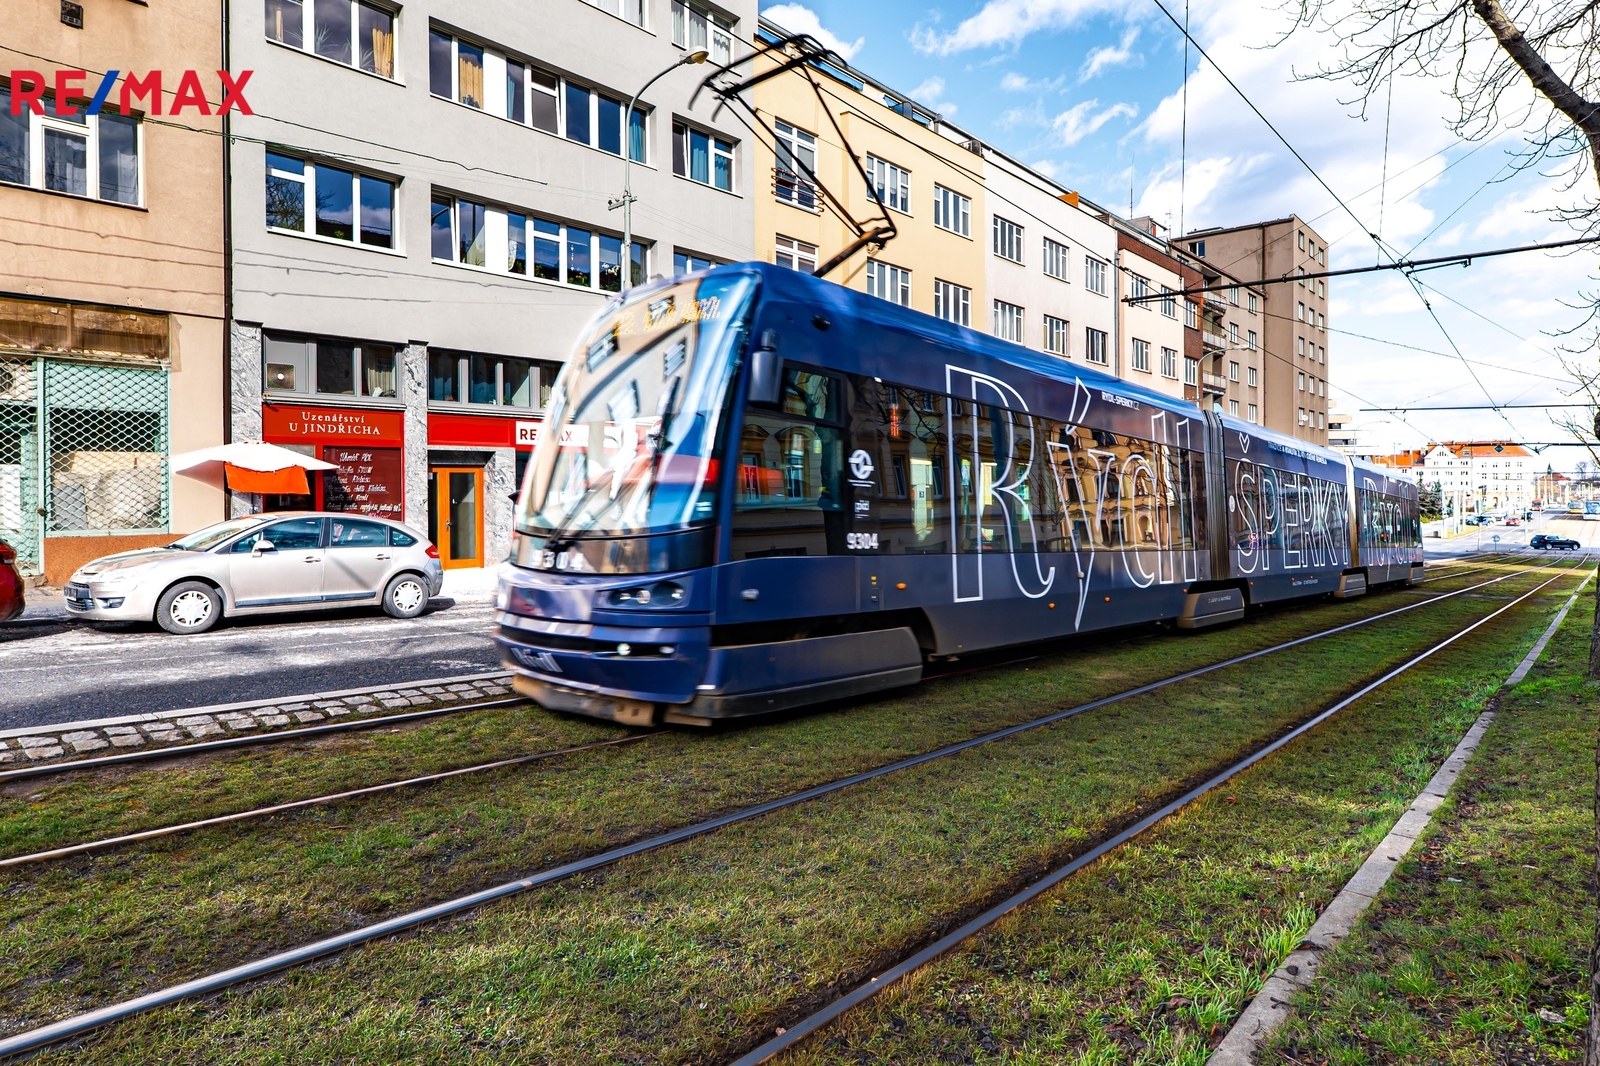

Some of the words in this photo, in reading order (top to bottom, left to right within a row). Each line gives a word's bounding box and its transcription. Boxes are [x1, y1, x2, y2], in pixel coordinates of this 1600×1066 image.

[301, 411, 365, 424] Uzenářství
[289, 423, 298, 432] U
[302, 423, 381, 435] JINDŘICHA
[846, 532, 880, 550] 9304
